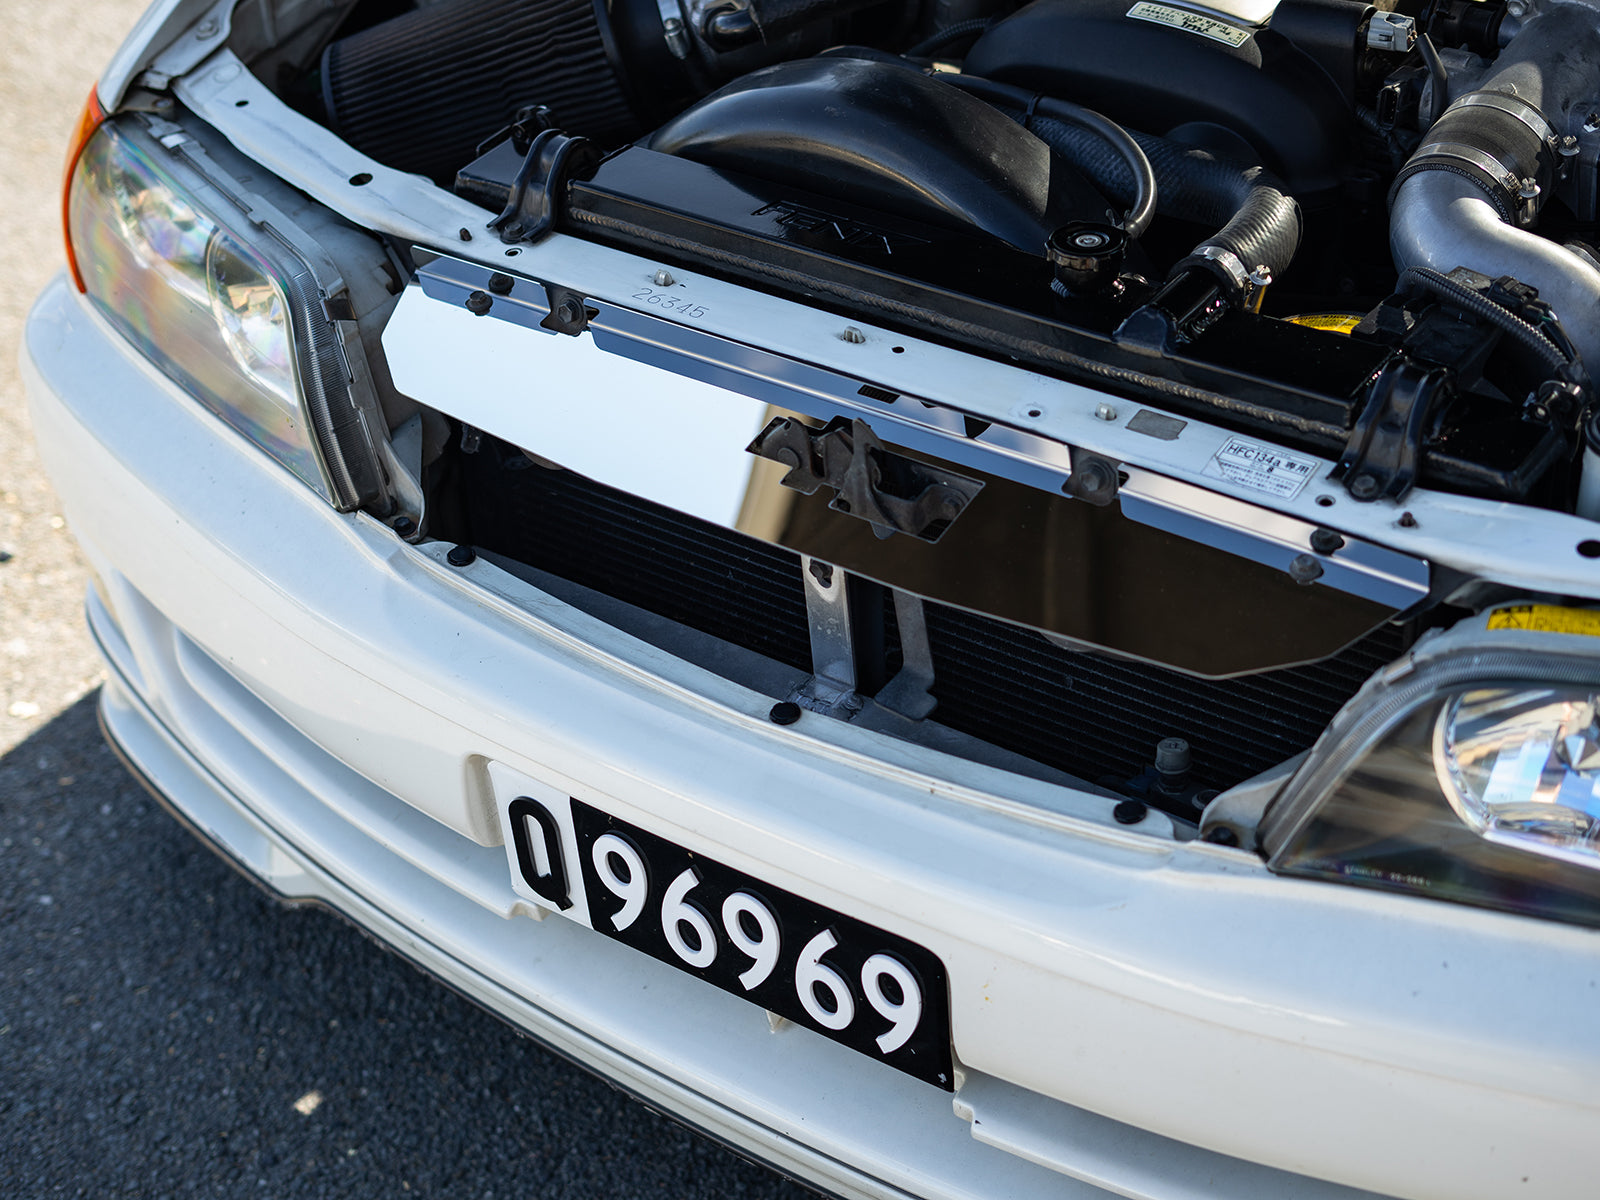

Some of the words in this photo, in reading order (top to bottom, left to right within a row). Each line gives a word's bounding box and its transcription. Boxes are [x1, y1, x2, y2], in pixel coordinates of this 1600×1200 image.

[631, 287, 711, 319] 26345
[1227, 443, 1282, 468] HFC134a
[507, 795, 574, 912] Q
[591, 830, 925, 1055] 96969
